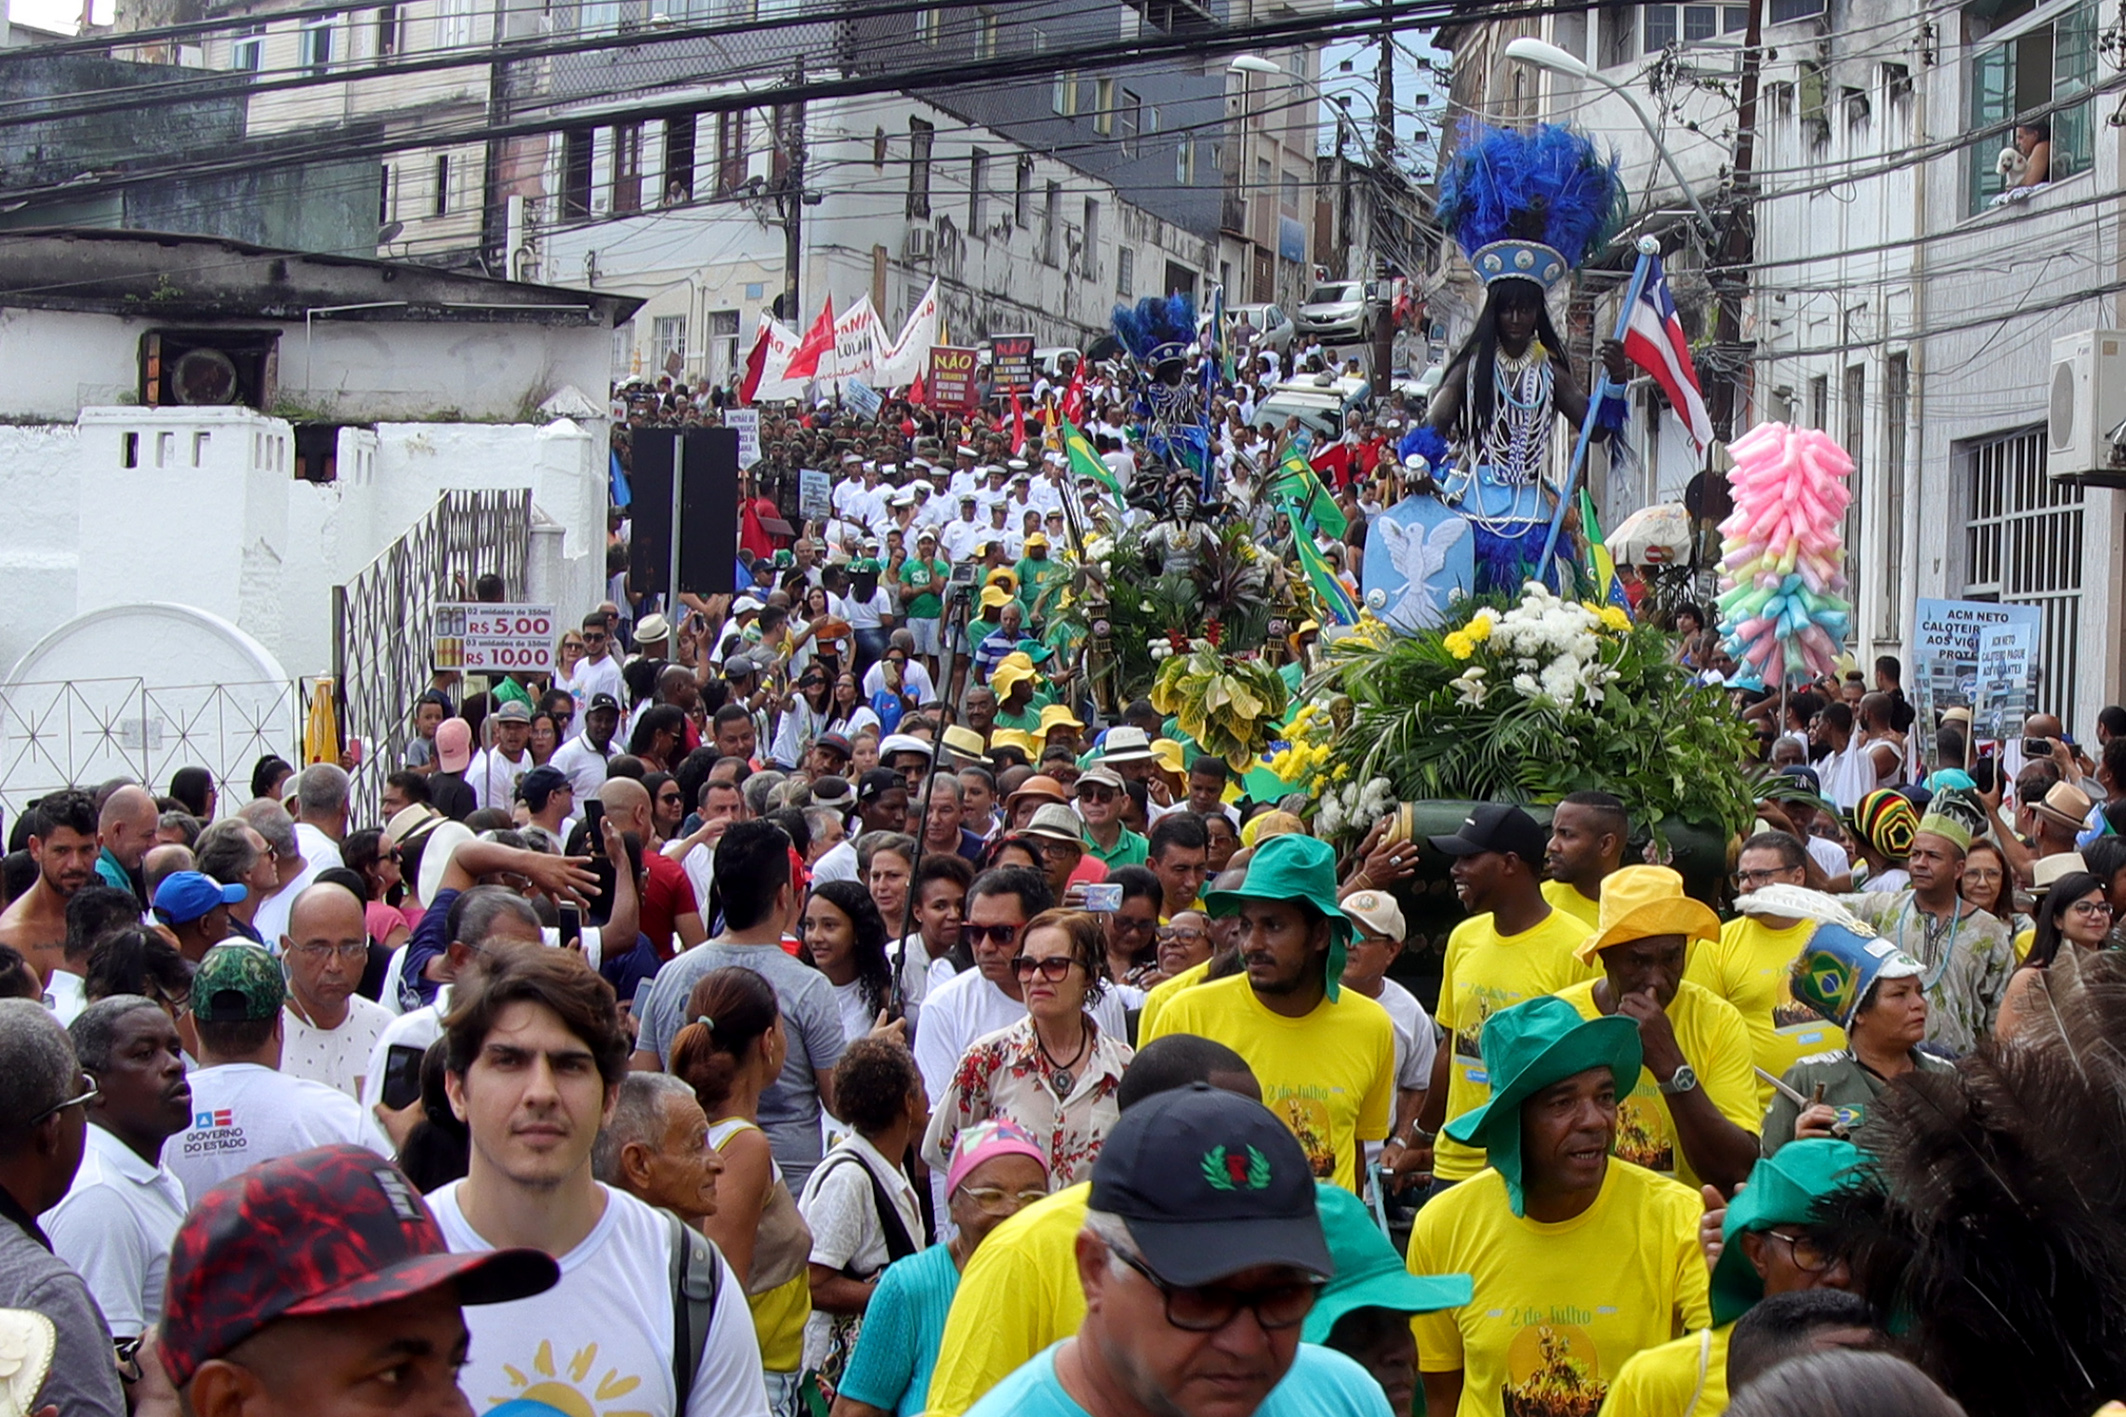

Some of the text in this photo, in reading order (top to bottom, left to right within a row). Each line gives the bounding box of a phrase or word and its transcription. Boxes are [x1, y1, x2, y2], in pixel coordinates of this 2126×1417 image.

[995, 339, 1030, 356] NÃO
[934, 352, 972, 370] NÃO
[480, 608, 514, 616] unidades
[1947, 609, 2009, 623] ACM NETO
[469, 618, 550, 636] R$ 5,00
[1922, 621, 1987, 635] CALOTEIR
[466, 638, 476, 647] 03
[478, 639, 514, 647] unidades
[1926, 635, 1951, 645] AOS
[1992, 634, 2015, 646] ACM NETO
[466, 649, 549, 667] R$ 10,00
[2007, 648, 2025, 660] PAGUE
[1268, 1084, 1328, 1100] 2 de Julho
[186, 1127, 243, 1142] GOVERNO
[184, 1138, 247, 1153] DO ESTADO
[1511, 1304, 1592, 1327] 2 de Julho
